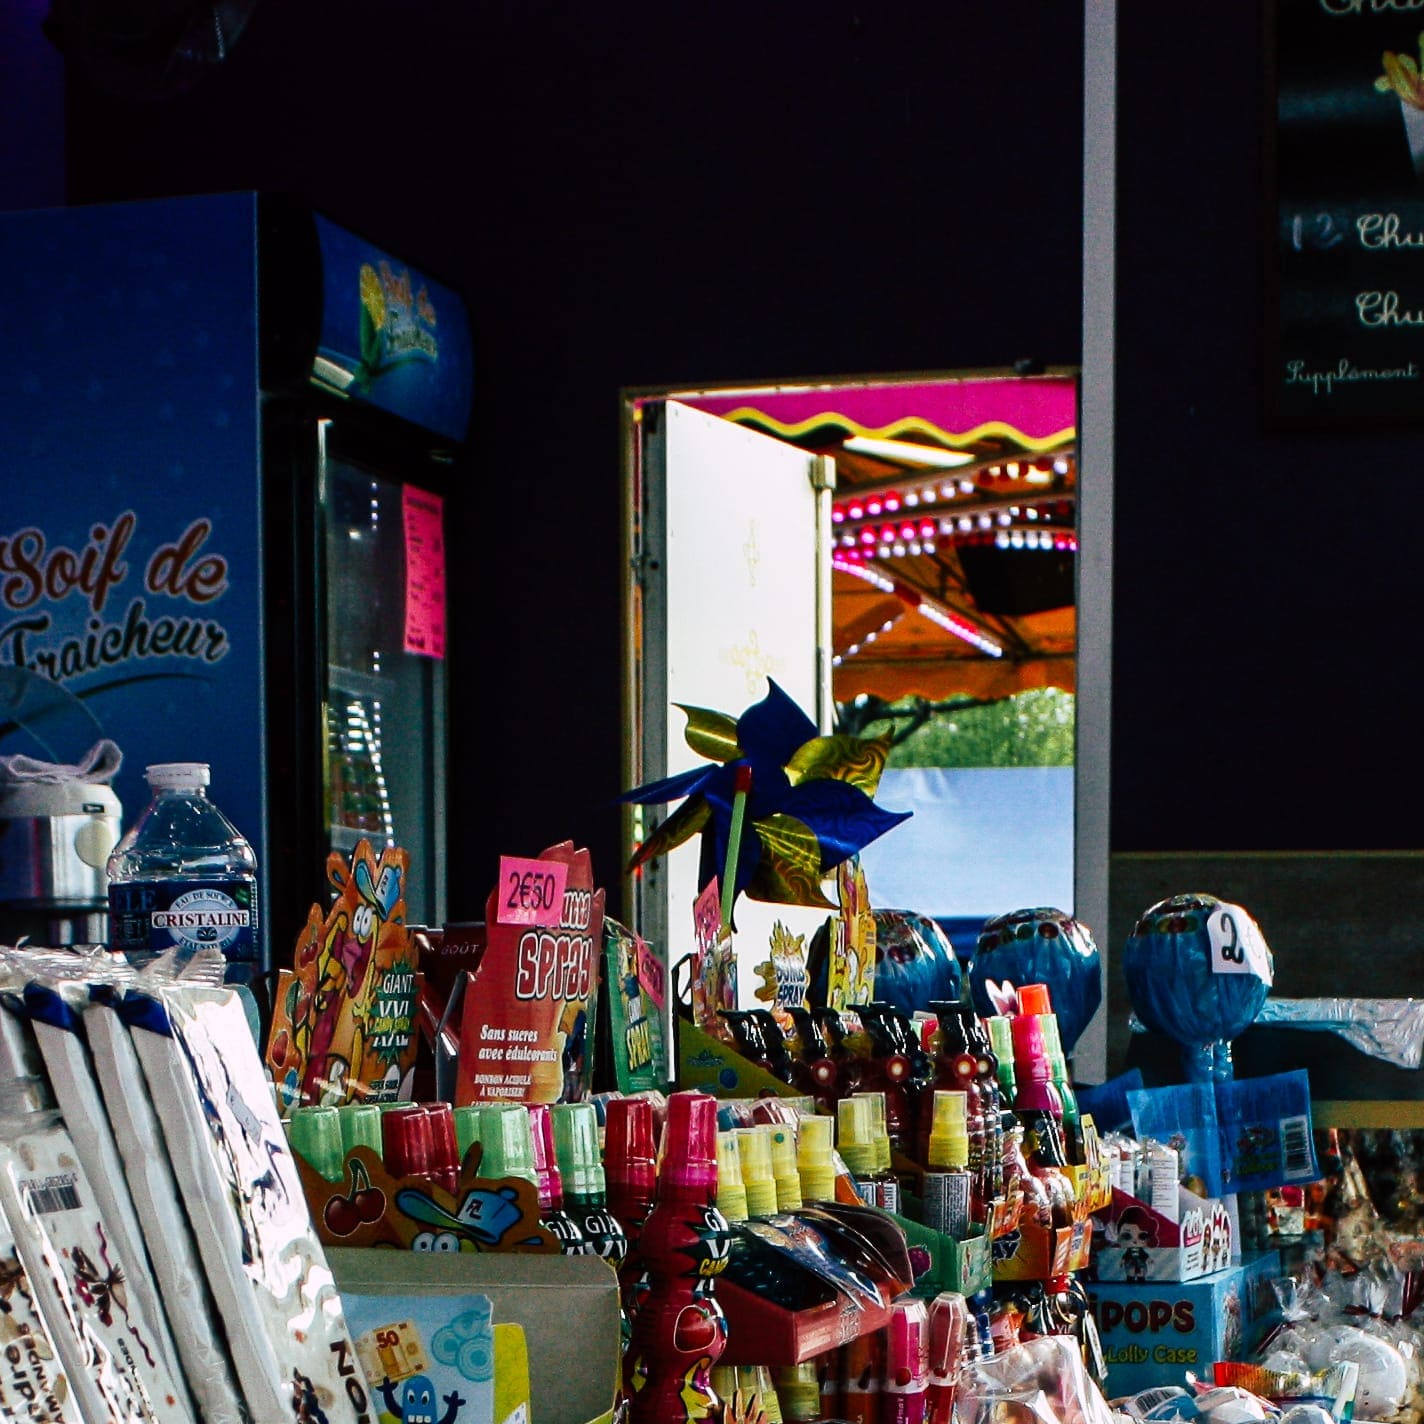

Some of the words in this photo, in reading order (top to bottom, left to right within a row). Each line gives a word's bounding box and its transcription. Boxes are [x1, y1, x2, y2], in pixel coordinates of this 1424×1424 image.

[144, 517, 230, 604] de
[507, 871, 556, 910] 2€50
[152, 910, 250, 930] CRISTALINE
[383, 975, 417, 994] GIANT
[480, 1025, 505, 1041] Sans
[506, 1028, 538, 1042] sucres
[478, 1047, 503, 1061] avec
[506, 1045, 557, 1062] édulcorants
[1154, 1345, 1198, 1364] Case
